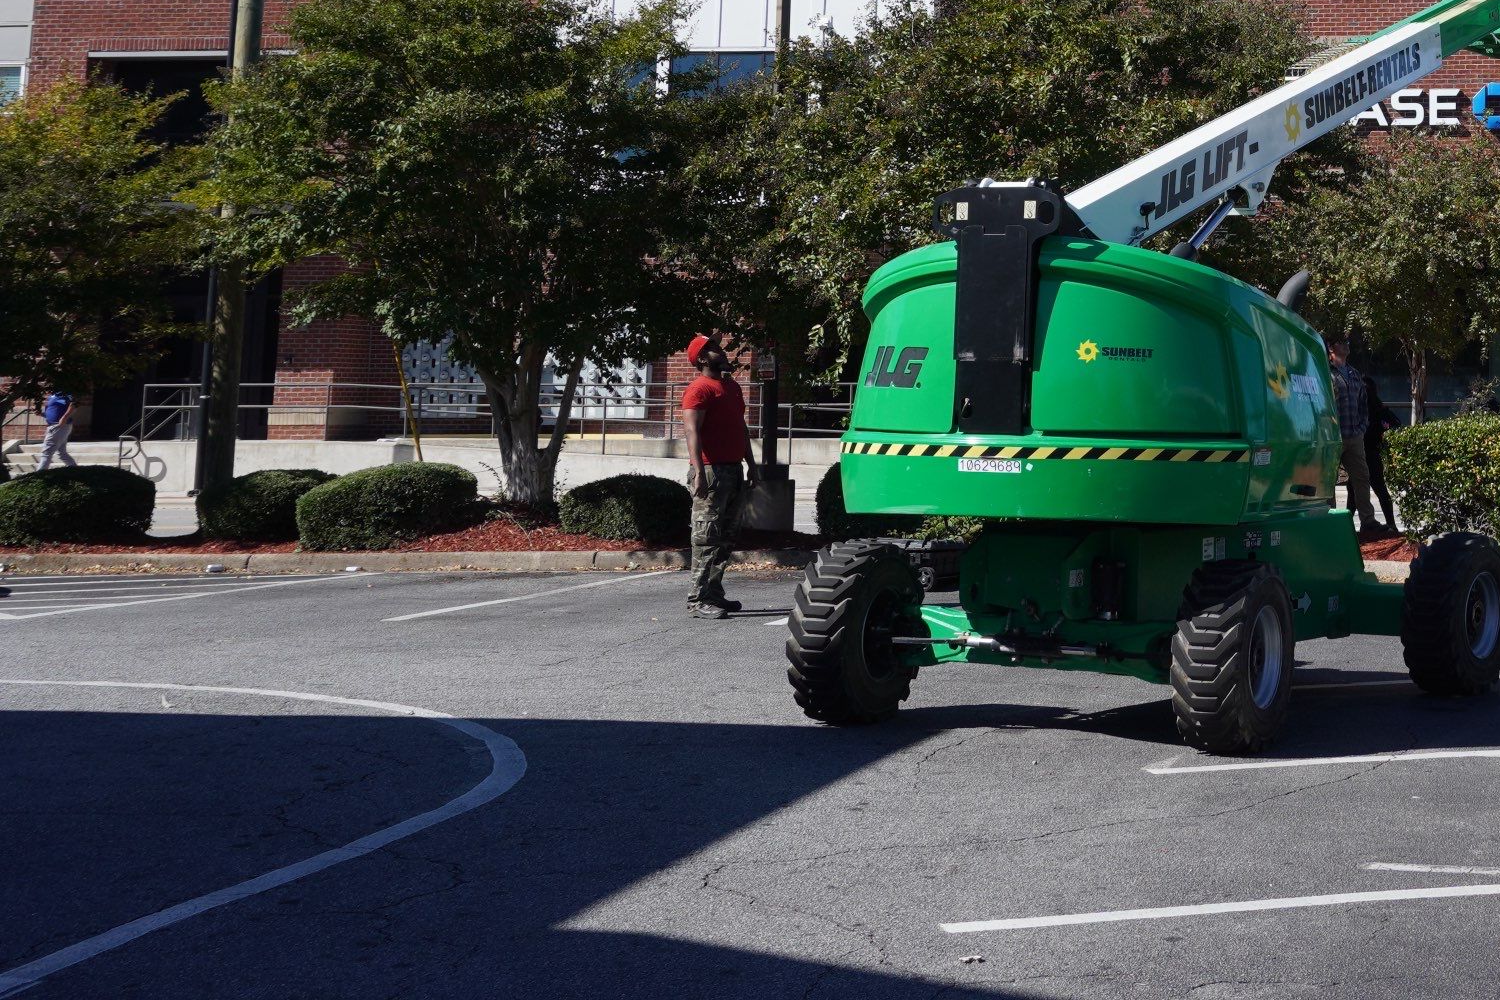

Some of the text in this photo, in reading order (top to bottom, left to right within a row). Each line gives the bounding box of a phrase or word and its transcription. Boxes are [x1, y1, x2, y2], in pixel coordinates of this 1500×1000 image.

[1348, 88, 1461, 126] ASE
[1155, 158, 1196, 220] JLG
[865, 346, 929, 389] JLG
[1101, 346, 1154, 358] SUNBELT
[959, 459, 1021, 472] 10629689
